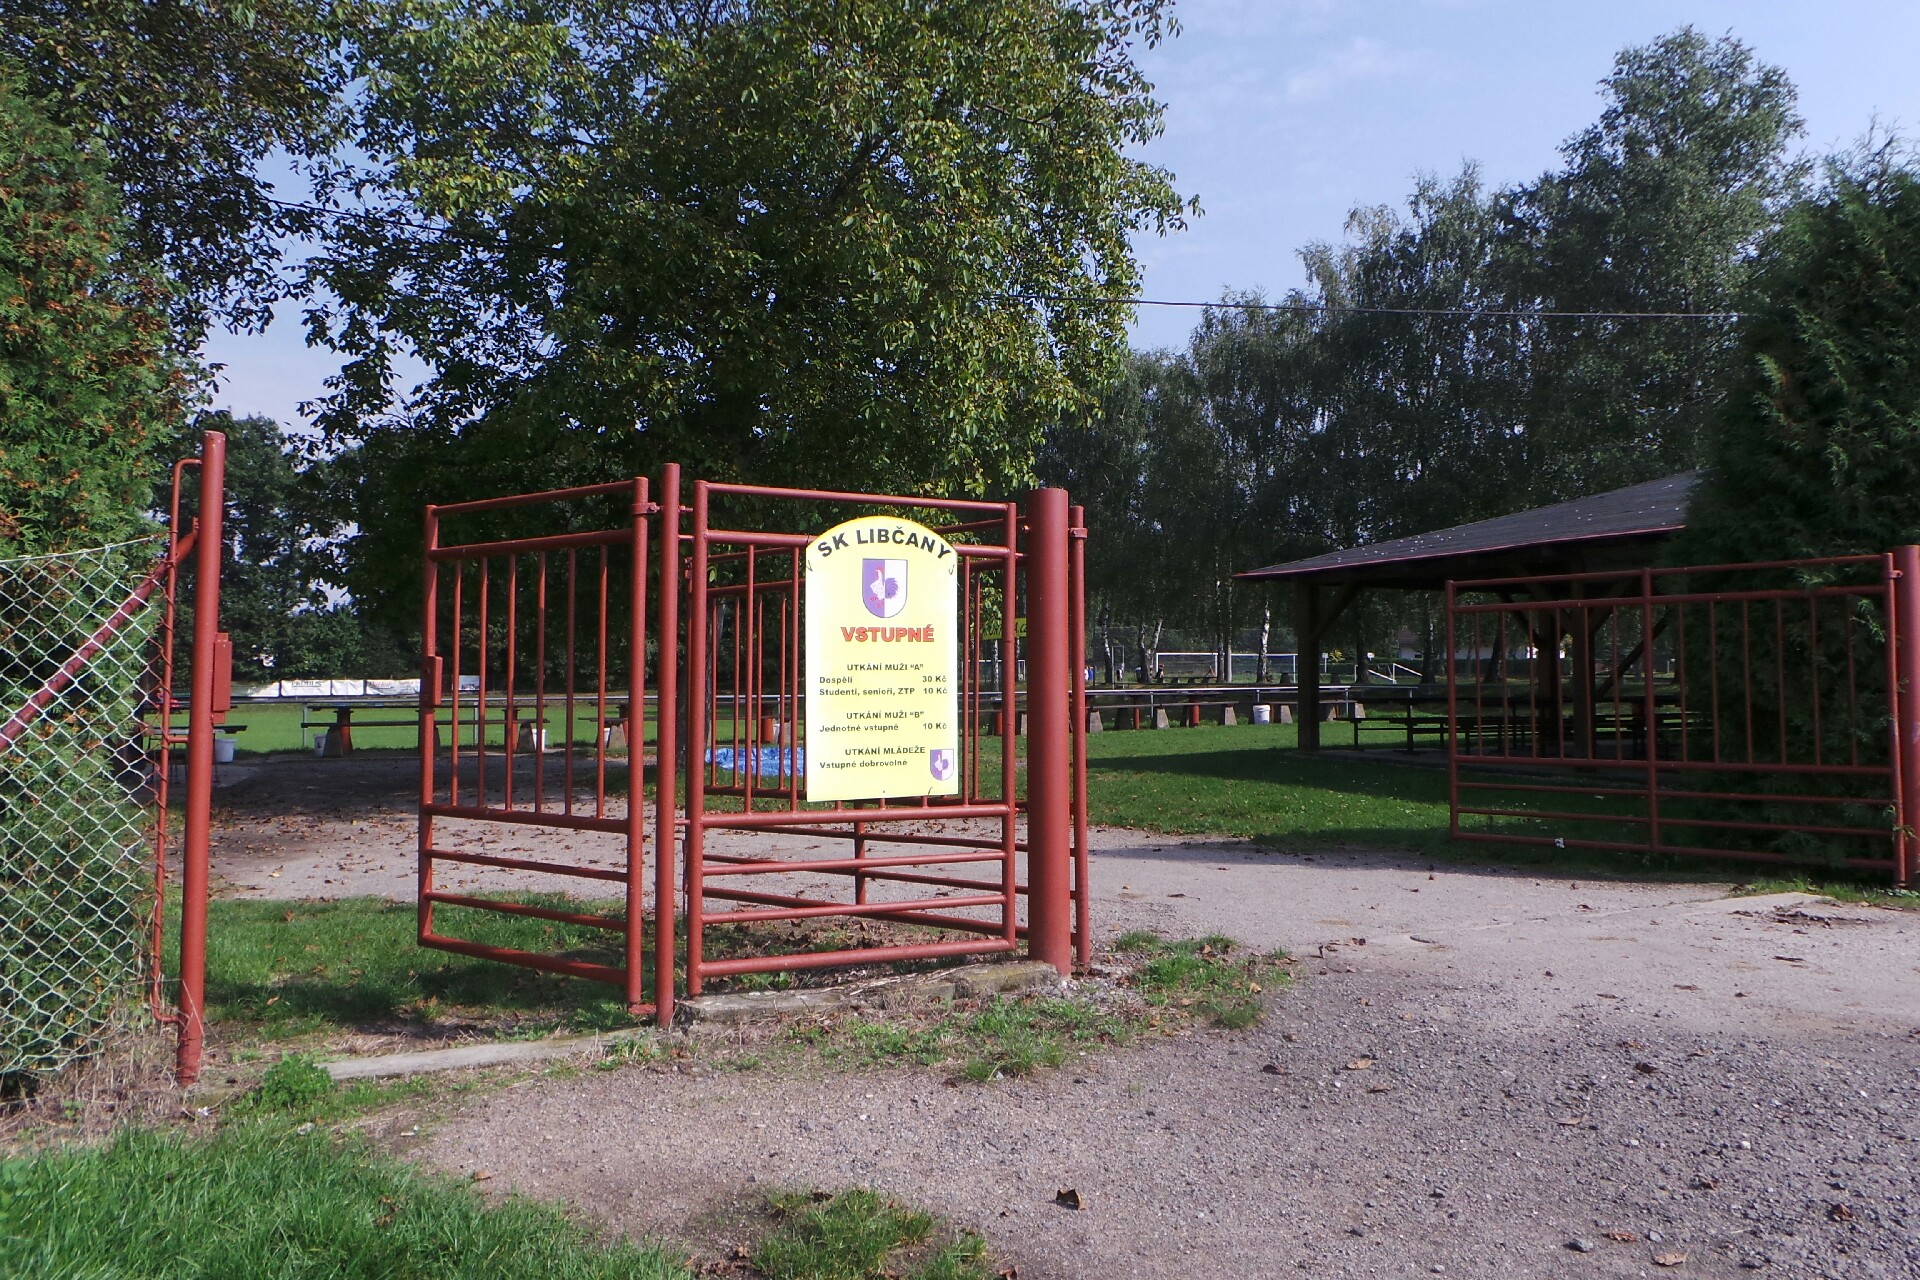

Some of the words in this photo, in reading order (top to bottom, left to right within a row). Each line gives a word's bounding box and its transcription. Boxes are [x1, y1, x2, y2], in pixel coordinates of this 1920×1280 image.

[817, 532, 850, 557] SK
[856, 526, 951, 559] LIBČANY
[840, 624, 935, 643] VSTUPNÉ
[847, 663, 882, 671] UTKÁNÍ
[885, 662, 908, 671] MUŽI
[819, 676, 853, 685] Dospělí
[922, 675, 933, 683] 30
[935, 675, 947, 683] Kč
[898, 687, 915, 695] ZTP
[923, 687, 934, 695] 10
[936, 687, 948, 695] Kč
[846, 711, 882, 720] UTKÁNÍ
[884, 710, 907, 719] MUŽI
[819, 724, 861, 732] Jednotné
[864, 723, 899, 732] vstupné
[922, 722, 933, 730] 10
[935, 722, 948, 730] Kč
[845, 747, 881, 756] UTKÁNÍ
[883, 746, 926, 754] MLÁDEŽE
[819, 761, 857, 769] Vstupné
[859, 759, 908, 767] dobrovolné
